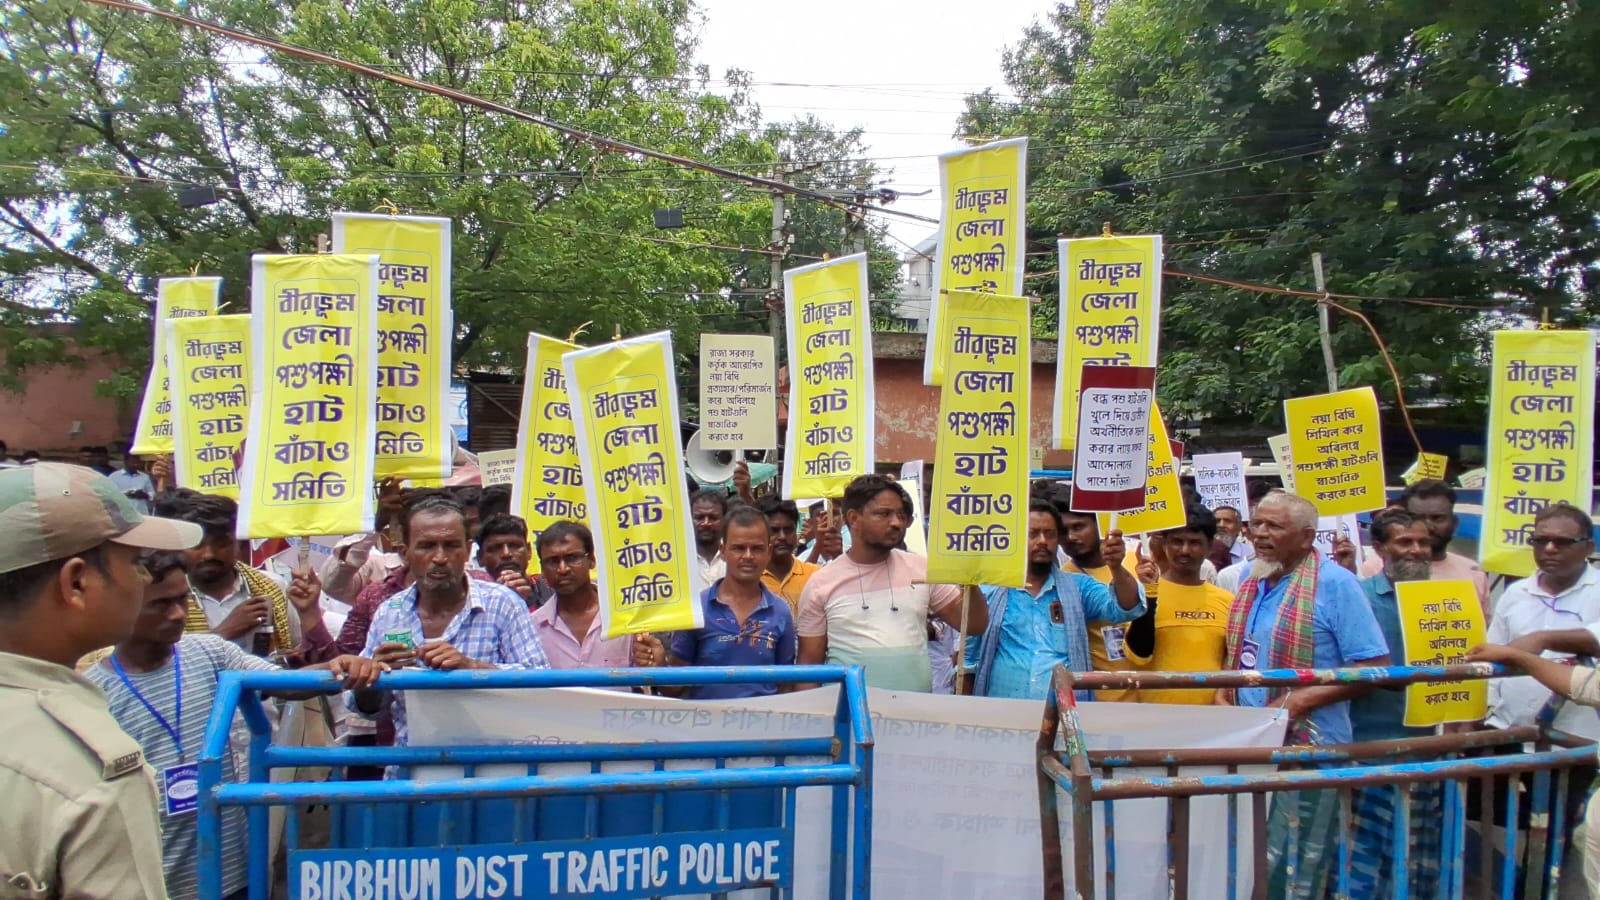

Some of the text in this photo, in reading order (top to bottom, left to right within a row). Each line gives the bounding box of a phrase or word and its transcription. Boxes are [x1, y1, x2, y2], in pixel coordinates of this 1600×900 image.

[955, 187, 1008, 214] বীরভূম
[956, 218, 1005, 242] জেলা
[951, 243, 1005, 275] পশুপক্ষী
[378, 264, 429, 289] রভূম
[1079, 259, 1142, 287] বীরভূম
[278, 288, 356, 319] বীরভূম
[802, 301, 852, 325] বীরভূম
[1081, 292, 1138, 313] জেলা
[282, 325, 352, 350] জেলা
[806, 329, 851, 353] জেলা
[1076, 316, 1139, 346] পশুপক্ষী
[185, 339, 242, 360] বীরভূম
[729, 349, 755, 358] সরকার
[954, 327, 1018, 364] বীরভূম
[191, 364, 242, 383] জেলা
[276, 354, 353, 389] পশুপক্ষী
[710, 371, 740, 381] নয়া বিধি
[730, 359, 763, 370] আরোপিত
[804, 352, 853, 385] পশুপক্ষী
[1506, 360, 1577, 388] বীরভূম
[954, 370, 1014, 395] জেলা
[155, 398, 171, 415] বাঁচ
[188, 384, 247, 410] পশুপক্ষী
[593, 389, 657, 420] বীরভূম
[809, 388, 848, 414] হাট
[1510, 395, 1574, 415] জেলা
[284, 395, 345, 425] হাট
[948, 401, 1015, 439] পশুপক্ষী
[1091, 410, 1110, 424] খুলে
[1312, 408, 1355, 424] নয়া বিধি
[152, 420, 172, 436] সমি
[198, 414, 243, 436] হাট
[708, 433, 744, 441] করতে হবে
[805, 422, 853, 446] বাঁচাও
[1306, 424, 1363, 440] শিথিল করে
[1504, 420, 1575, 451] পশুপক্ষী
[274, 434, 350, 465] বাঁচাও
[375, 431, 424, 456] মিতি
[604, 424, 658, 454] জেলা
[1089, 443, 1114, 454] করার
[196, 442, 233, 463] বাঁচা
[805, 451, 852, 475] সমিতি
[954, 446, 1008, 476] হাট
[1341, 451, 1378, 467] হাটগুলি
[199, 467, 236, 488] সমি
[605, 453, 665, 492] পশুপক্ষী
[1087, 476, 1107, 486] পাশে
[1148, 461, 1173, 477] টগুলি
[1512, 458, 1566, 482] হাট
[272, 472, 347, 501] সমিতি
[1315, 486, 1367, 501] করতে হবে
[534, 492, 587, 519] বাঁচাও
[946, 485, 1013, 515] বাঁচাও
[1149, 500, 1167, 511] হবে
[616, 496, 663, 529] হাট
[946, 524, 1010, 552] সমিতি
[1502, 524, 1536, 546] সমি
[616, 538, 672, 569] বাঁচাও
[621, 573, 673, 606] সমিতি
[1423, 598, 1462, 614] নয়া বিধি
[1419, 618, 1471, 632] শিথিল করে
[1425, 691, 1470, 705] করতে হবে
[300, 840, 780, 900] BIRBHUM DIST TRAFFIC POLICE
